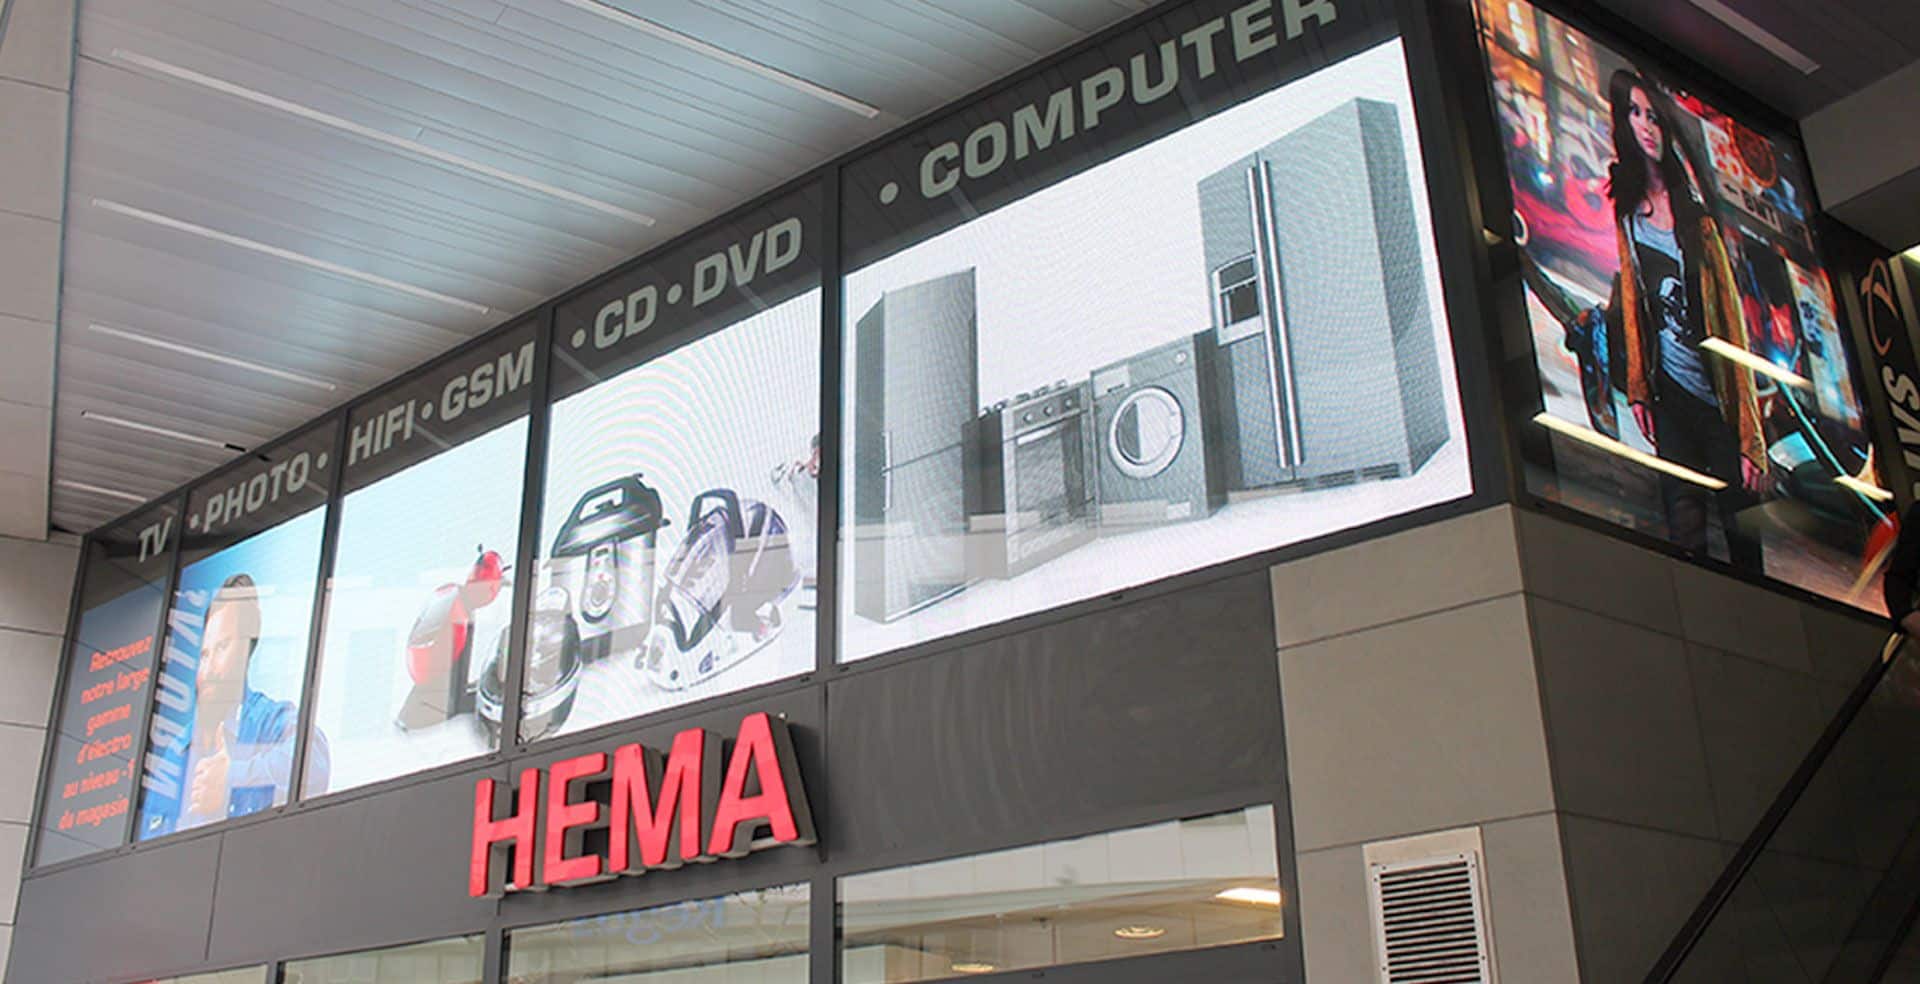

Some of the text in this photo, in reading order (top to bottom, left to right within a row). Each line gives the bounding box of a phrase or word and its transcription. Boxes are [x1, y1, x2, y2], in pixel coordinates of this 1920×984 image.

[138, 0, 1337, 563] TV PHOTO HIFI GSM CD DVD COMPUTER
[81, 667, 150, 705] notre large
[86, 703, 131, 737] gamme
[63, 781, 79, 799] au
[80, 769, 121, 794] niveau
[57, 793, 129, 831] du magasin
[469, 712, 799, 898] HEMA
